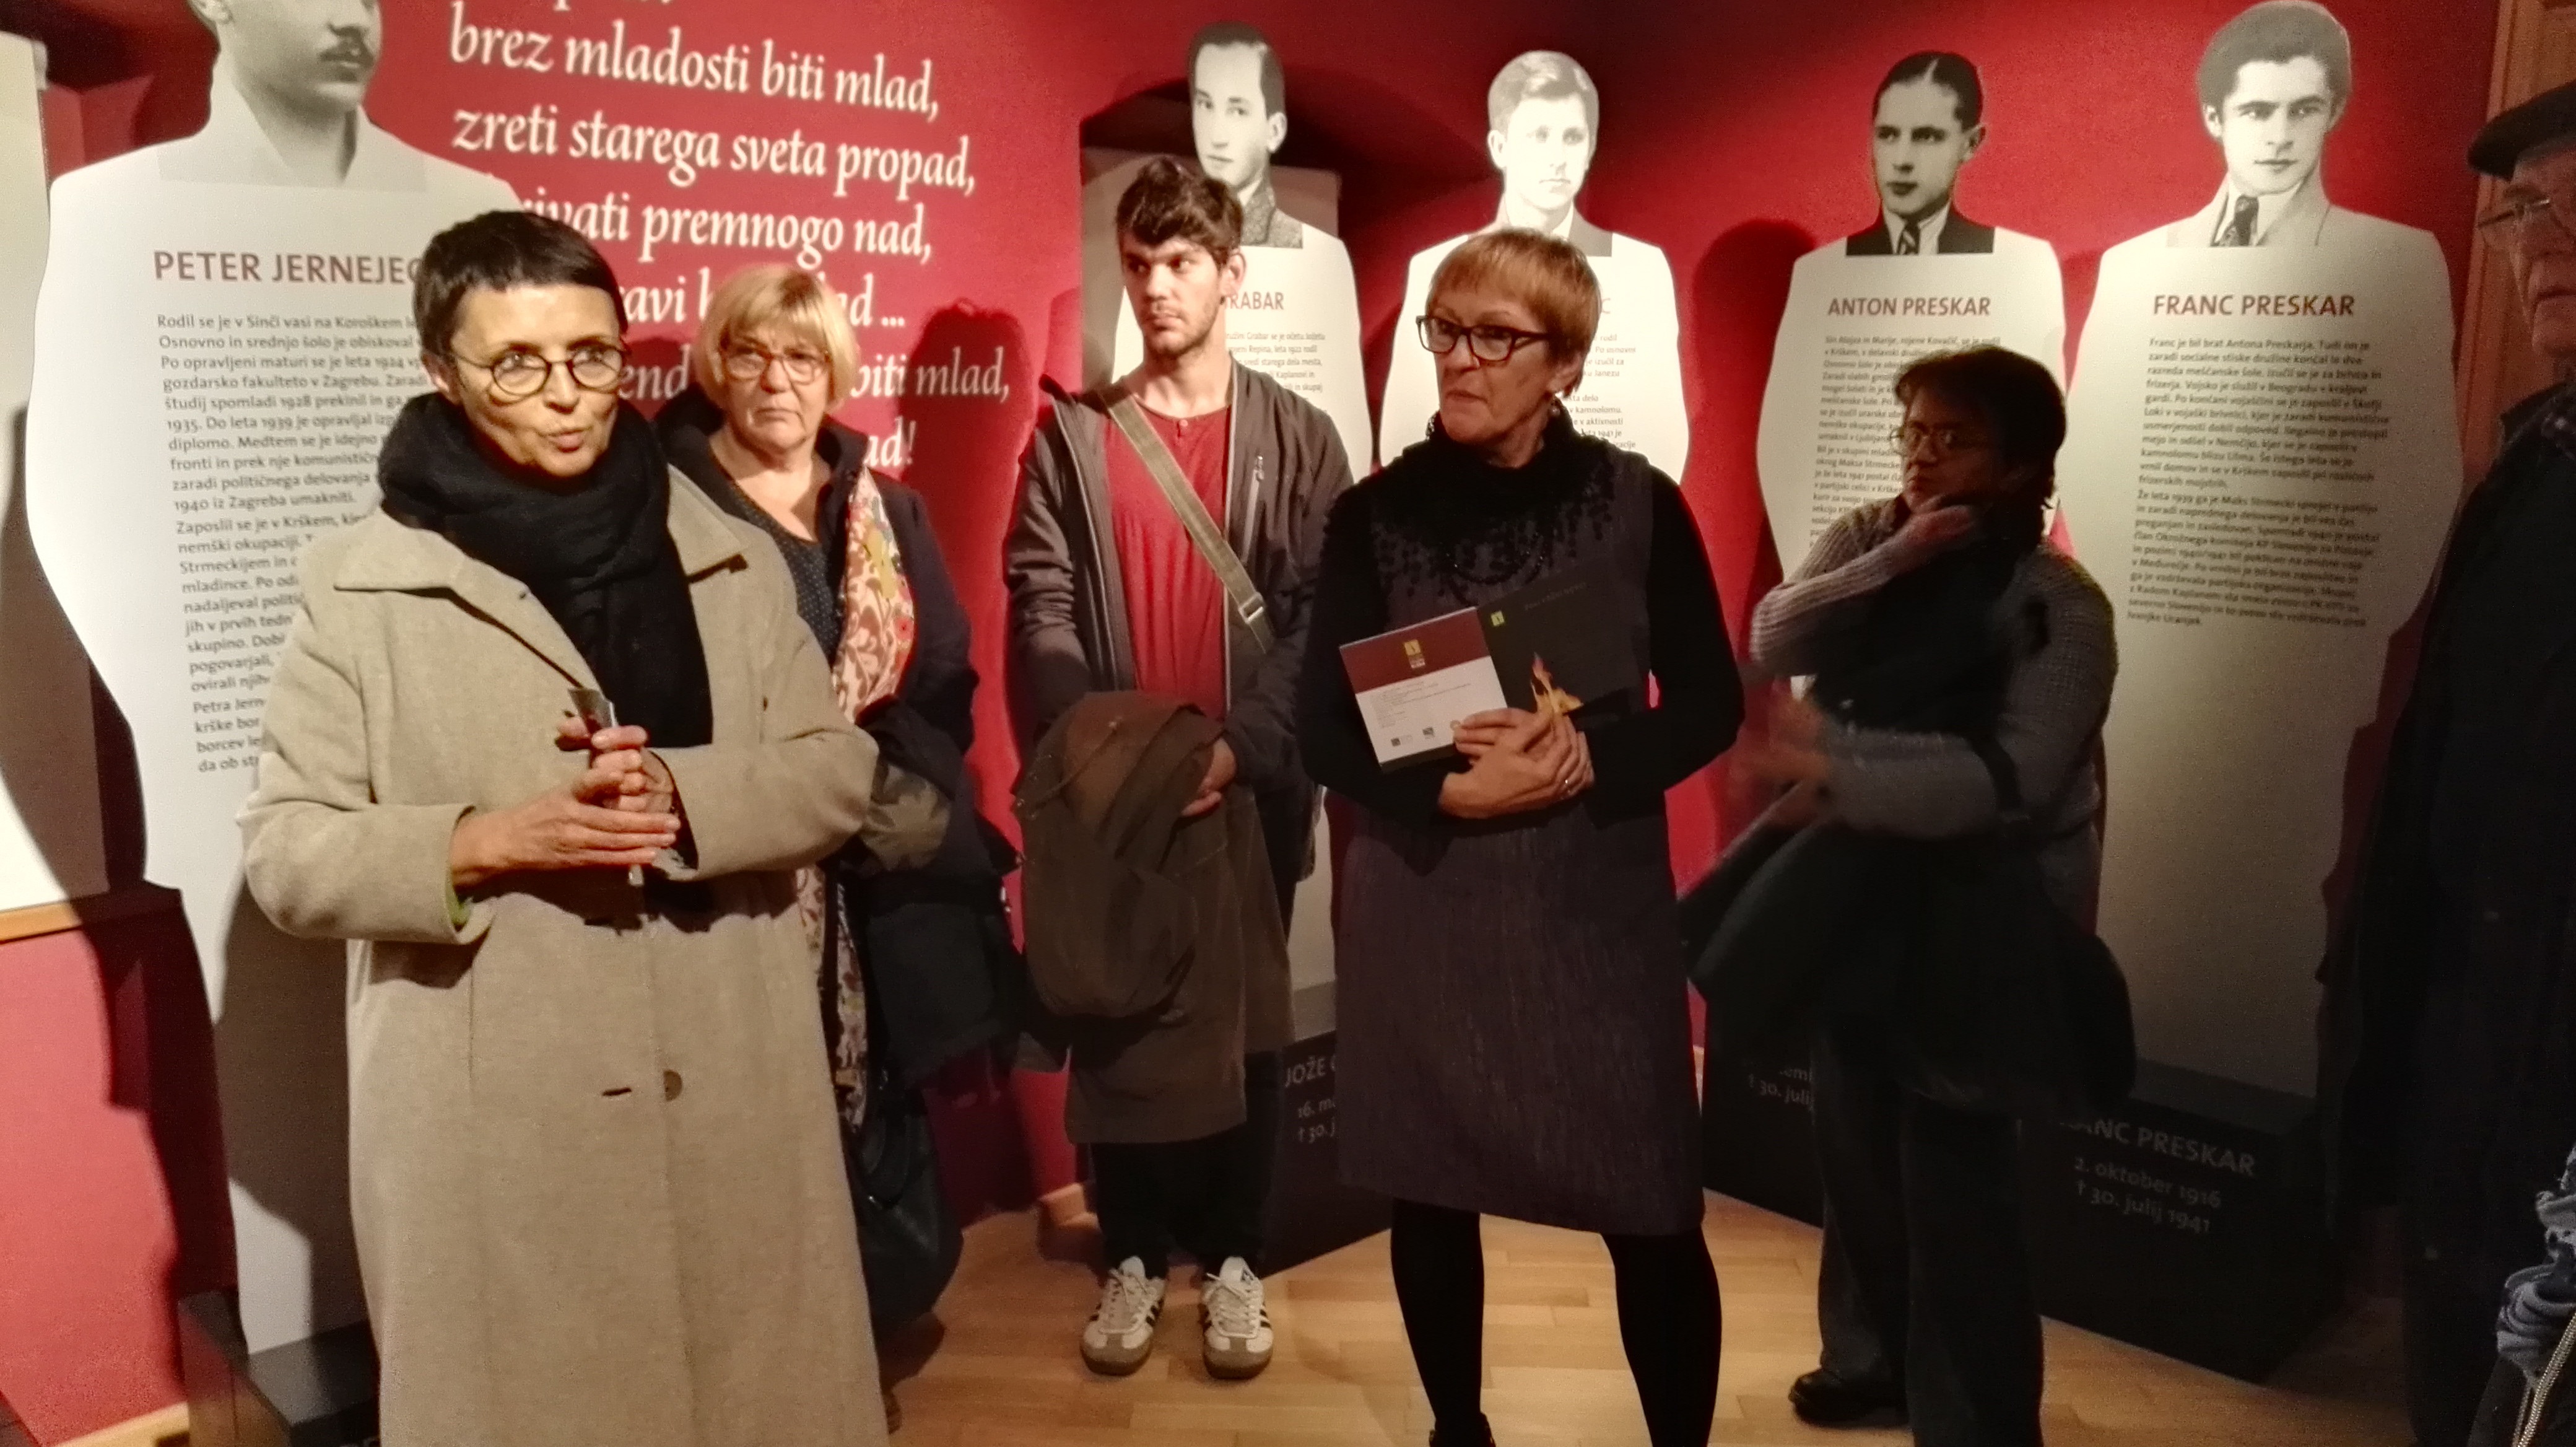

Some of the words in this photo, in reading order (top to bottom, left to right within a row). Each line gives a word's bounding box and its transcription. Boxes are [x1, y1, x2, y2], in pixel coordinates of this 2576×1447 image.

[451, 0, 554, 72] brez
[565, 18, 749, 92] mladosti
[762, 38, 824, 101] biti
[834, 52, 939, 120] mlad,
[452, 103, 558, 156] zreti
[569, 109, 721, 186] starega
[731, 136, 825, 177] sveta
[835, 136, 975, 202] propad,
[638, 196, 843, 269] premnogo
[853, 202, 932, 265] nad,
[154, 250, 263, 282] PETER
[1225, 291, 1285, 310] RABAR
[1828, 297, 1897, 316] ANTON
[1902, 297, 1991, 316] PRESKAR
[2154, 294, 2233, 316] FRANC
[2241, 294, 2355, 317] PRESKAR
[157, 313, 195, 329] Rodil
[199, 317, 215, 329] se
[218, 314, 231, 332] je
[234, 318, 243, 329] v
[315, 318, 333, 329] na
[159, 334, 226, 349] Osnovno
[228, 334, 243, 349] in
[160, 354, 180, 370] Po
[183, 354, 256, 373] opravljeni
[916, 345, 1010, 404] mlad,
[162, 375, 239, 393] gozdarsko
[206, 415, 227, 430] Do
[230, 415, 258, 430] leta
[1284, 1054, 1326, 1088] JOŽE
[2138, 1126, 2256, 1177] PRESKAR
[2094, 1161, 2174, 1194] oktober
[2179, 1184, 2222, 1209] 1916
[2090, 1187, 2121, 1208] 30.
[2122, 1192, 2164, 1226] julij
[2167, 1208, 2211, 1235] 1941
